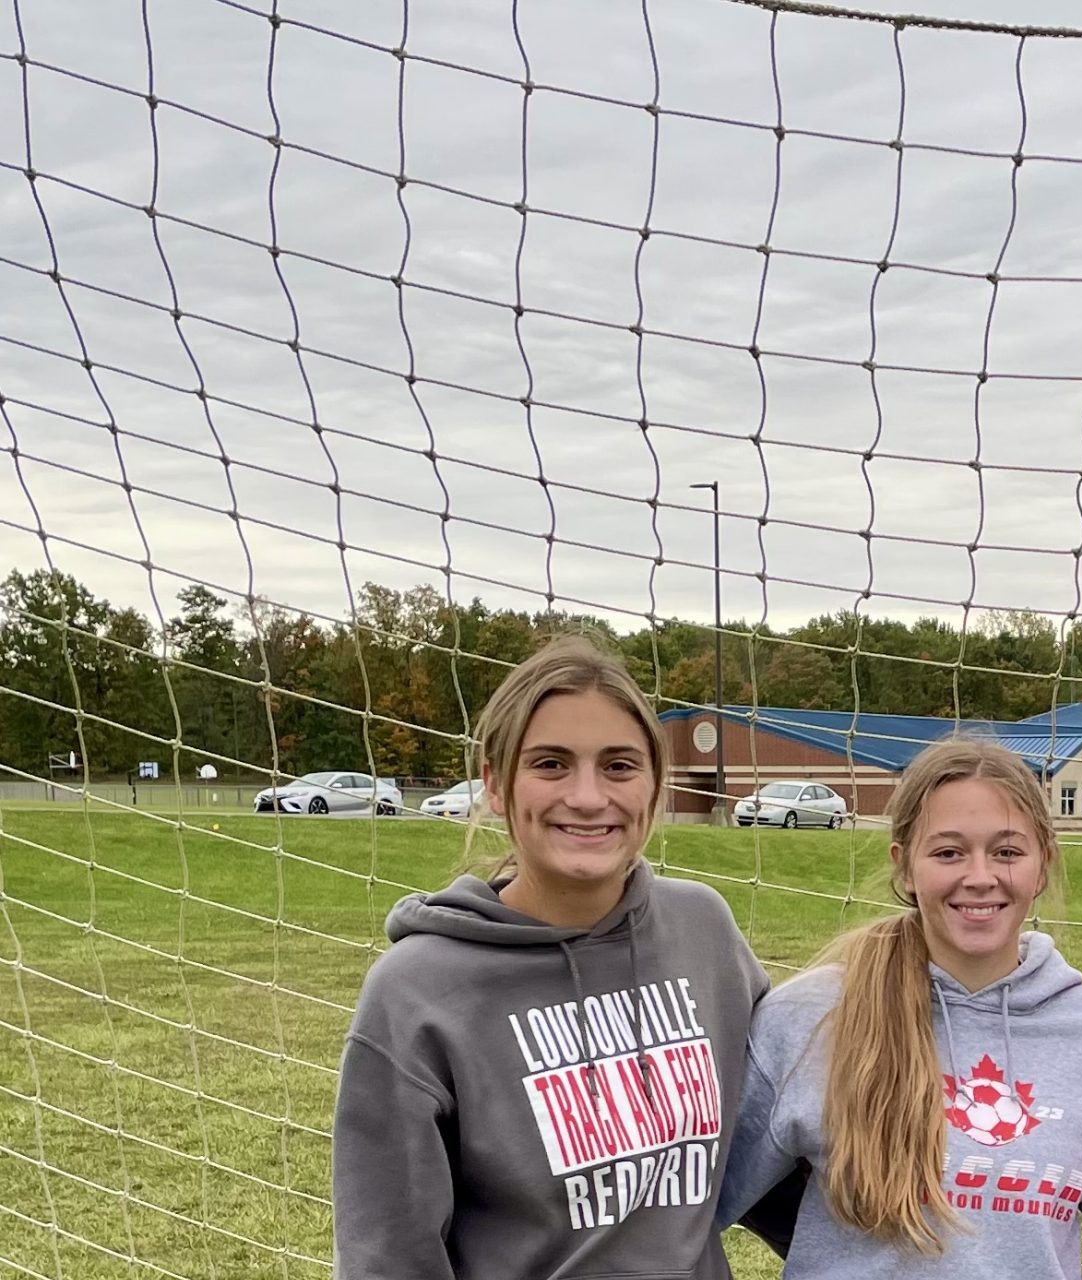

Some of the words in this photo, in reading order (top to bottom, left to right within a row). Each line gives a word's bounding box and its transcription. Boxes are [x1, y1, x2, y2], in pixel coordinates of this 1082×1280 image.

[508, 978, 704, 1072] LOUDONVILLE
[534, 1064, 634, 1167] TRACK
[616, 1053, 676, 1147] AND
[664, 1044, 719, 1137] FIELD
[1035, 1106, 1064, 1119] 23
